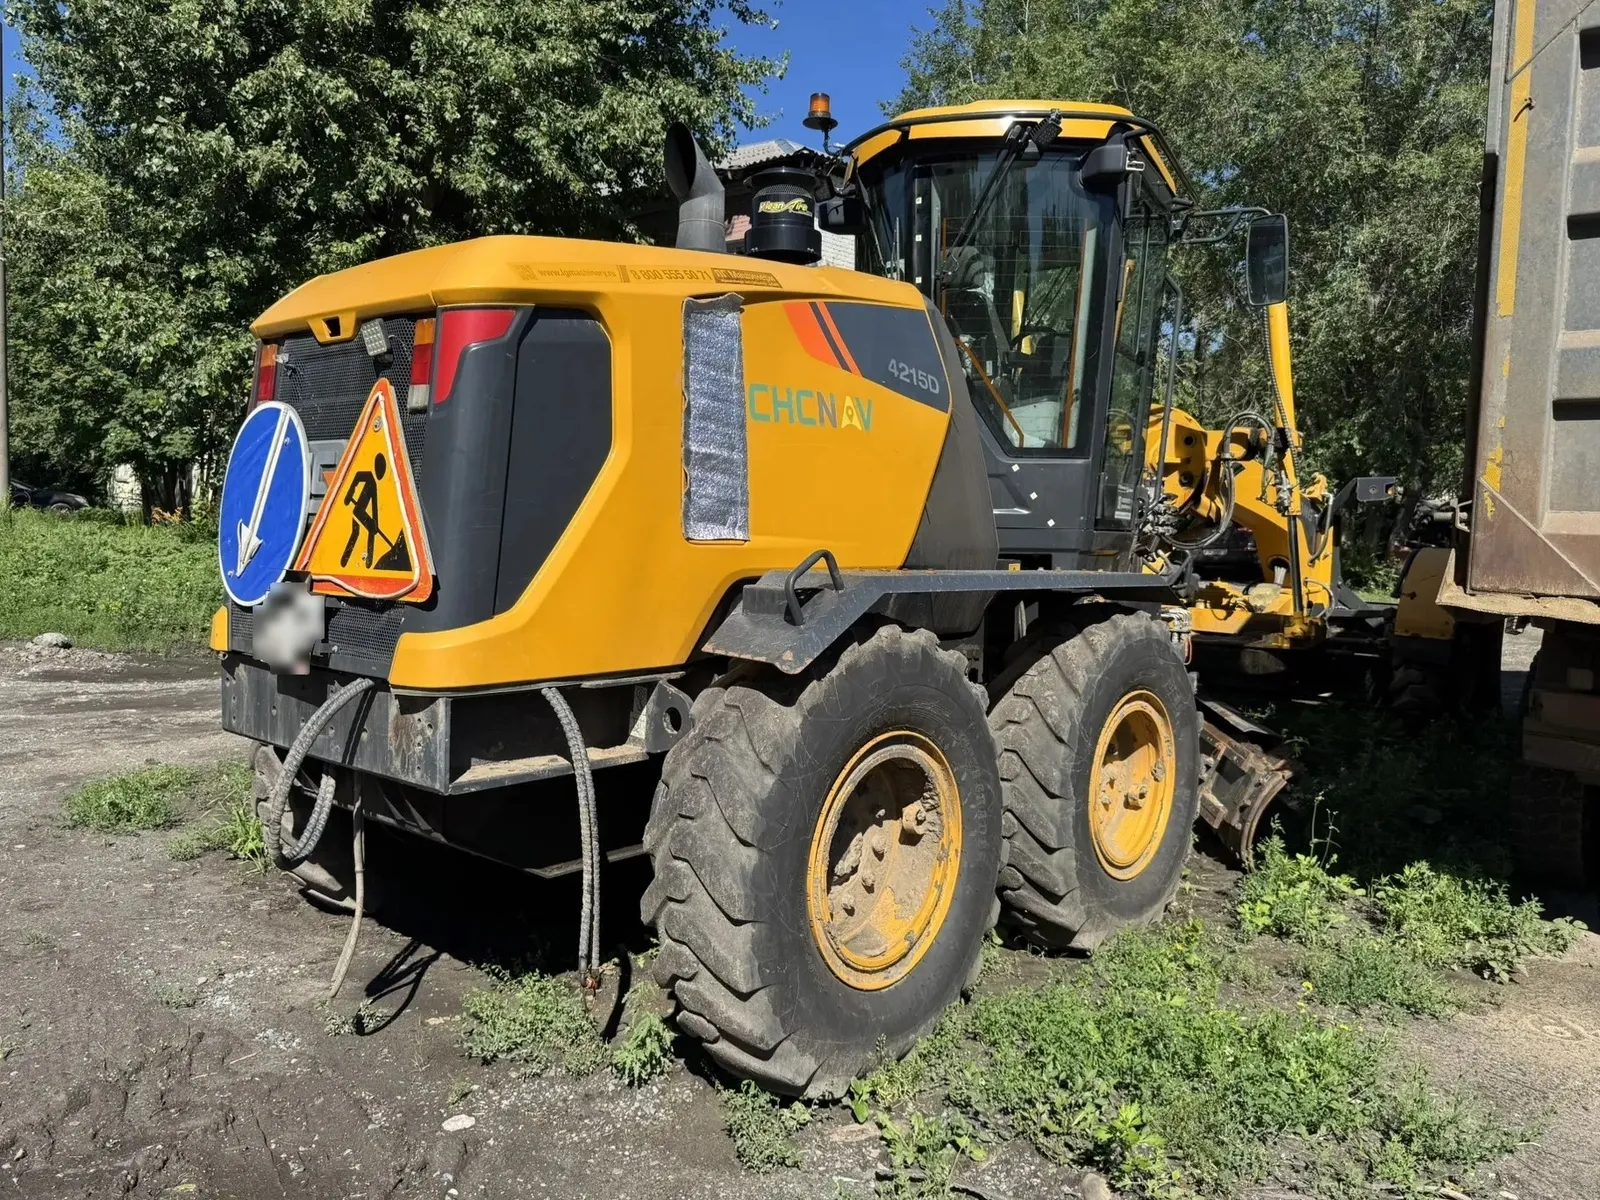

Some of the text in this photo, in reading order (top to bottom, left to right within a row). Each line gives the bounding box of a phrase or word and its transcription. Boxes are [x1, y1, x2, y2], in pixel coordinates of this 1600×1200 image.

[631, 269, 641, 280] 8
[640, 270, 664, 280] 800
[662, 270, 685, 280] 555
[683, 270, 699, 280] 50
[696, 270, 713, 281] 71
[888, 358, 940, 395] 4215D
[749, 382, 874, 432] CHCNAV
